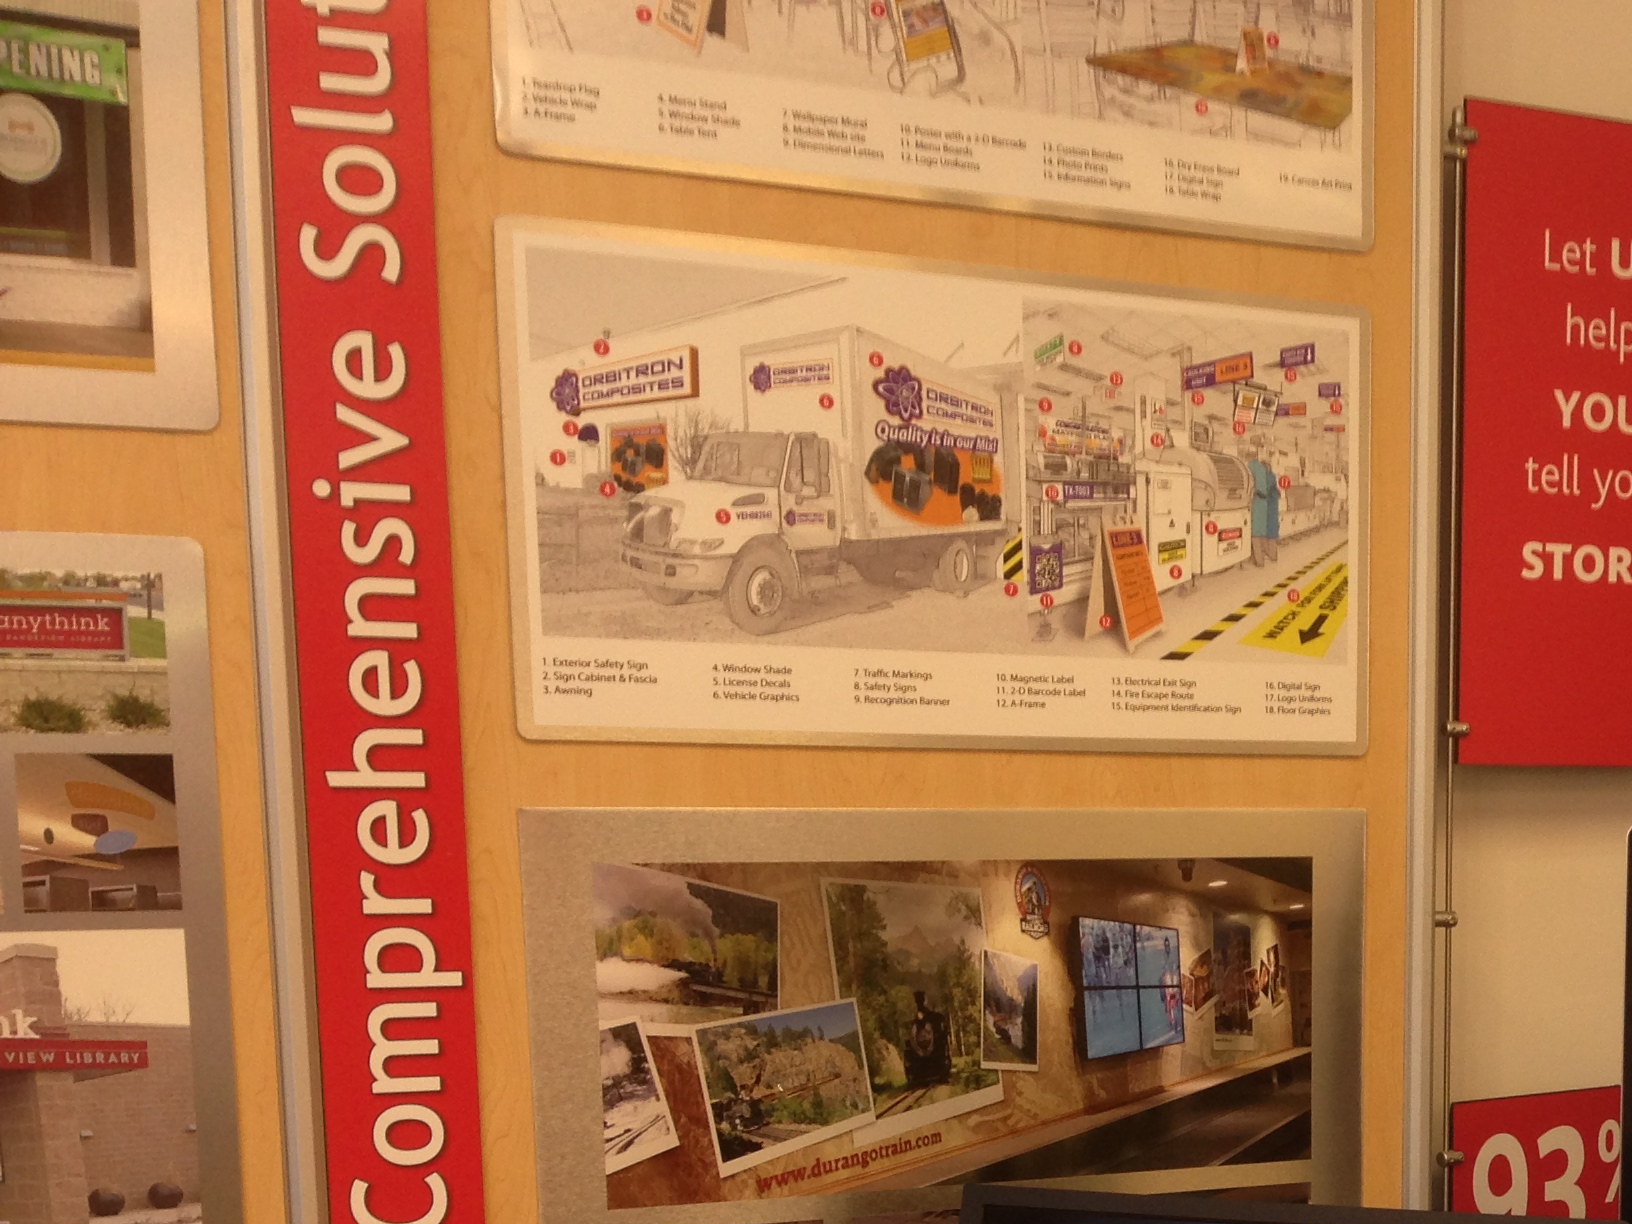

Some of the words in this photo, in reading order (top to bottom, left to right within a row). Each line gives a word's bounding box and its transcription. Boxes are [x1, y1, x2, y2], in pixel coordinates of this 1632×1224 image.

[1544, 227, 1597, 276] Let
[582, 355, 684, 388] ORBITRON
[582, 375, 685, 402] COMPOSITES
[876, 420, 929, 448] Quality
[930, 428, 941, 445] is
[1525, 452, 1581, 497] tell
[0, 613, 110, 633] anythink
[552, 657, 591, 668] Exterior
[594, 658, 624, 671] Safety
[627, 659, 648, 672] Sign
[554, 672, 576, 682] Sign
[578, 672, 616, 682] Cabinet
[618, 674, 627, 683] &
[629, 674, 657, 684] Fascia
[723, 678, 758, 687] License
[761, 678, 791, 688] Decals
[1010, 673, 1049, 684] Magnetic
[1052, 674, 1075, 684] Label
[554, 685, 593, 698] Awning
[4, 1050, 55, 1064] VIEW
[65, 1051, 140, 1064] LIBRARY
[755, 1131, 943, 1194] www.durangotrain.com
